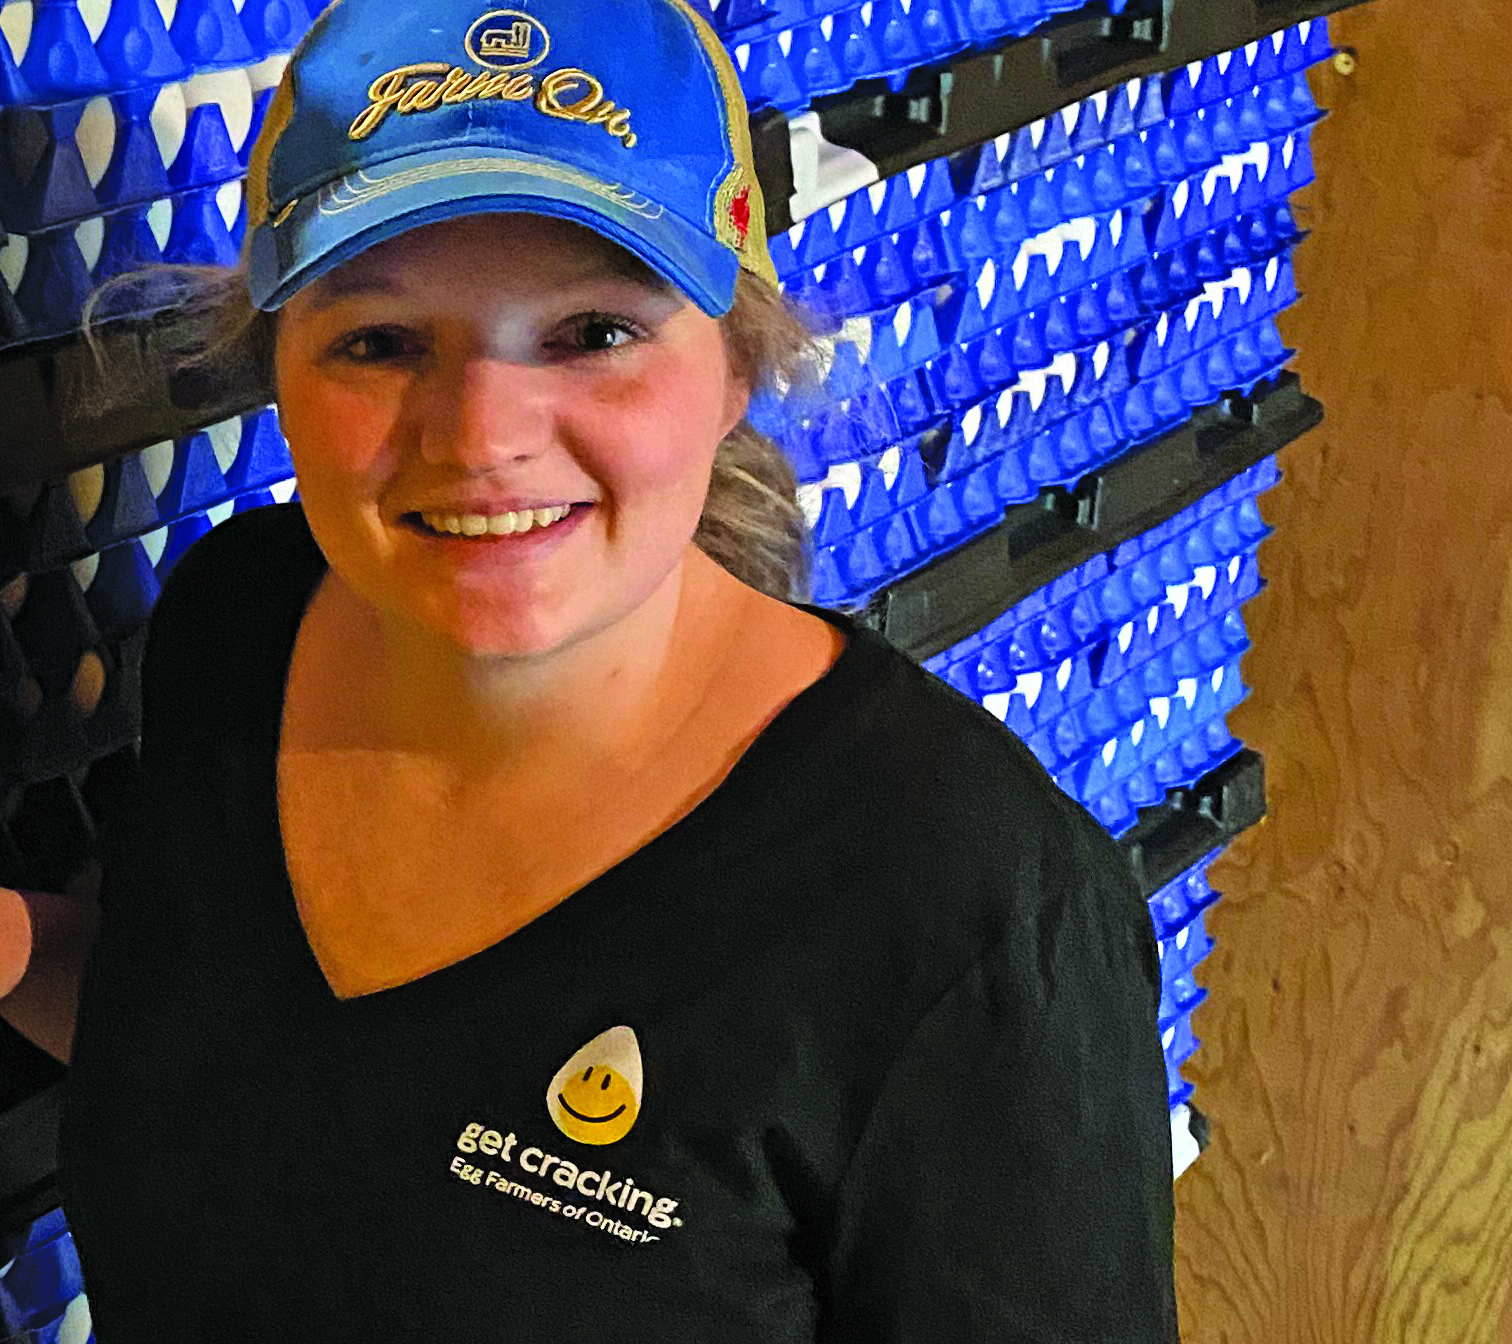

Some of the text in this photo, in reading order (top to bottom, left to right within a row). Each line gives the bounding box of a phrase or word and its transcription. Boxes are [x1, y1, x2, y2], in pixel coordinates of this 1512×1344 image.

[348, 62, 533, 140] Farm
[456, 1122, 517, 1162] get
[449, 1156, 482, 1185] Egg
[486, 1170, 562, 1213] Farmers
[562, 1203, 587, 1220] of
